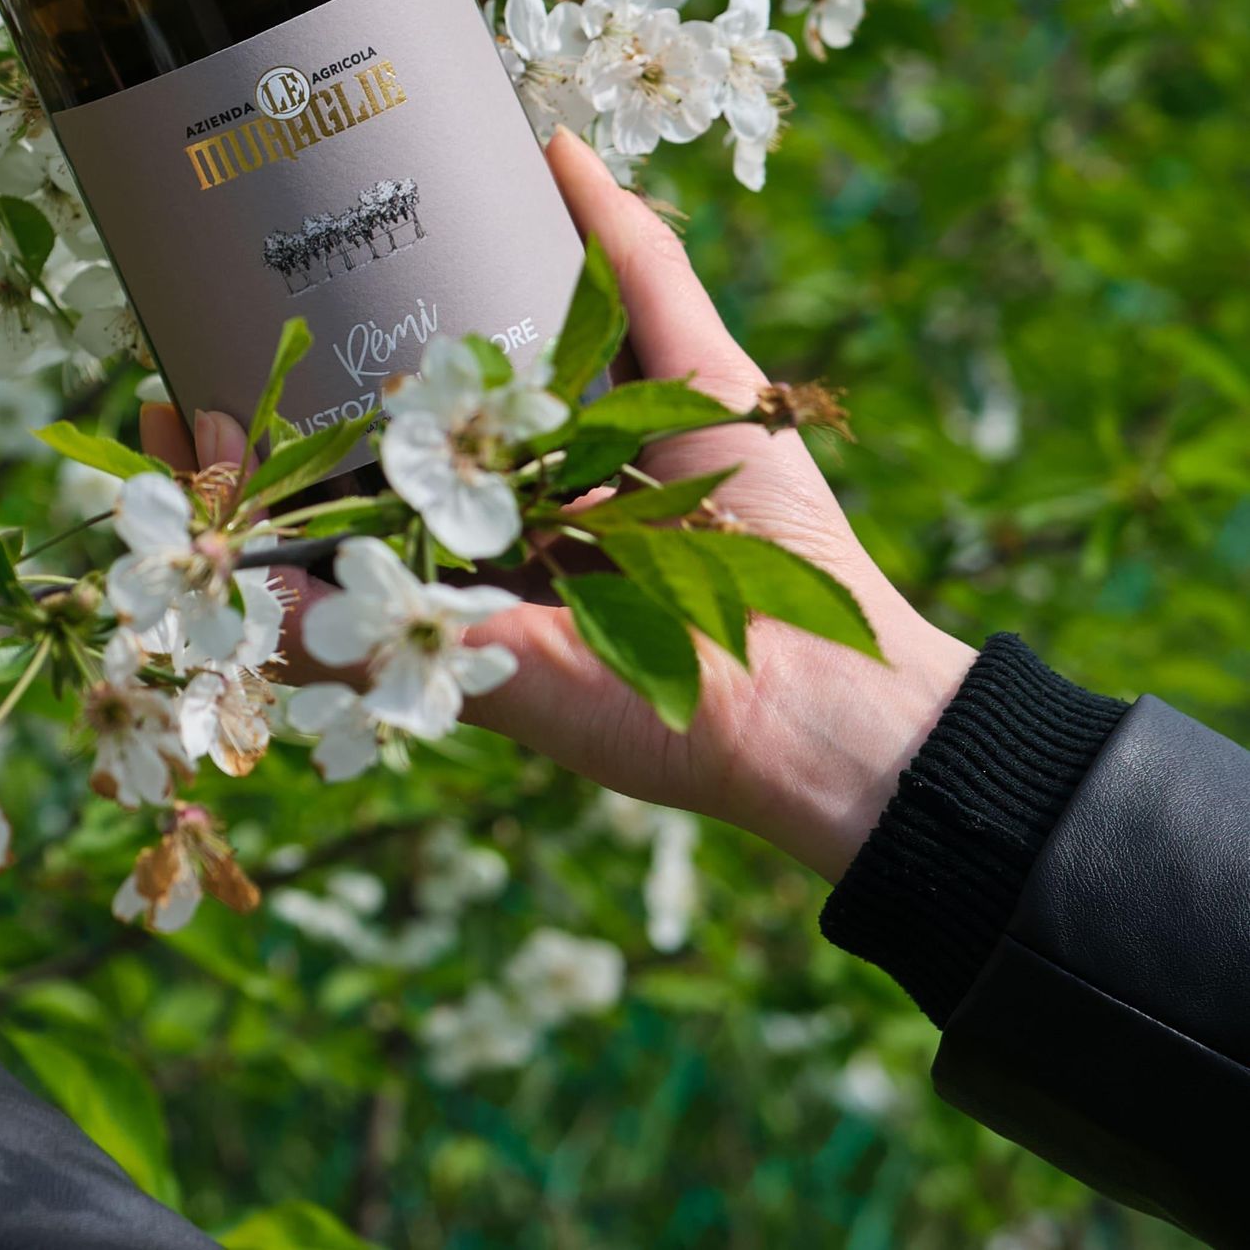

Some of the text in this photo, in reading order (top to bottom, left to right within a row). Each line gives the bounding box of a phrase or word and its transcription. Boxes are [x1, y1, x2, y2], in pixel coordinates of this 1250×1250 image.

[183, 60, 408, 191] MURAGLIE
[186, 46, 378, 139] AZIENDA LE AGRICOLA
[332, 298, 438, 388] Rèmi
[294, 390, 376, 439] USTOZ
